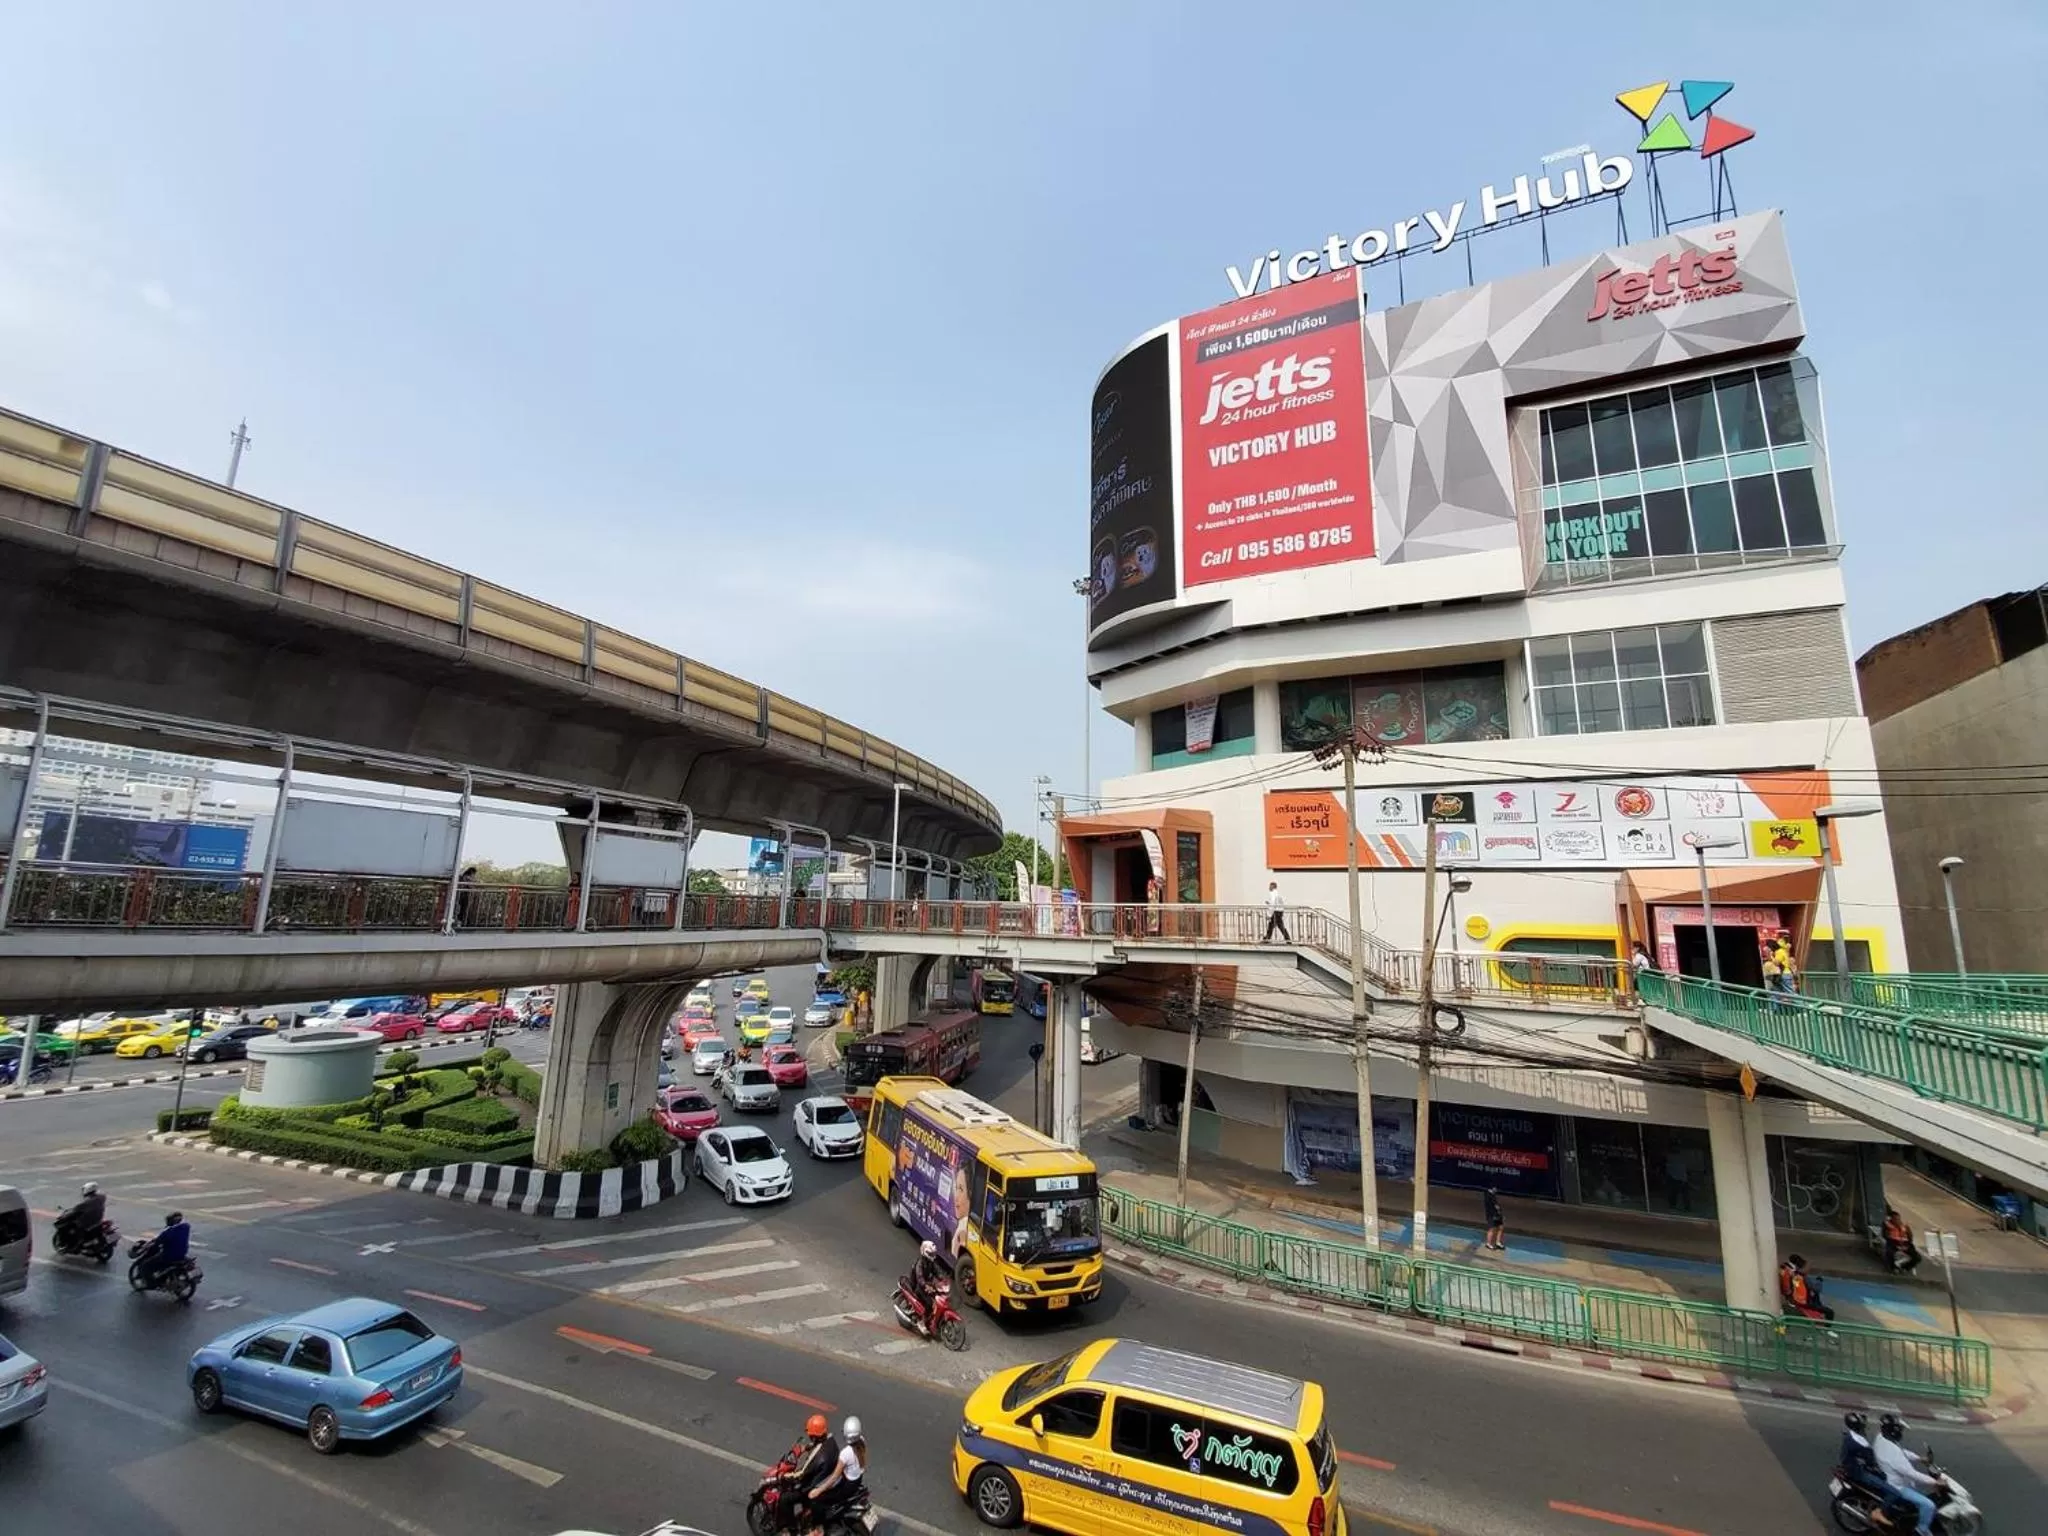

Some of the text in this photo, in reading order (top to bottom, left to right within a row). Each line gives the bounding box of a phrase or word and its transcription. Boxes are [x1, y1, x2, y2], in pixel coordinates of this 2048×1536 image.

[1225, 152, 1634, 298] Victory Hub
[1588, 250, 1737, 322] jetts
[1237, 314, 1250, 326] 24
[1613, 306, 1635, 320] 24
[1639, 296, 1682, 315] hour
[1205, 339, 1232, 357] เพียง
[1200, 353, 1332, 424] jetts
[1221, 388, 1335, 426] 24 hour fitness
[1208, 419, 1337, 468] VICTORY HUB
[1203, 519, 1228, 531] Access
[1228, 517, 1236, 526] to
[1264, 510, 1271, 518] in
[1317, 495, 1355, 508] worldwide
[1208, 500, 1233, 515] Only
[1234, 495, 1257, 510] THB
[1201, 524, 1352, 568] Call 095 586 8785
[1567, 531, 1628, 559] YOUR
[1291, 812, 1330, 831] เร็วๆนี้
[1205, 1434, 1283, 1488] กตัญญู
